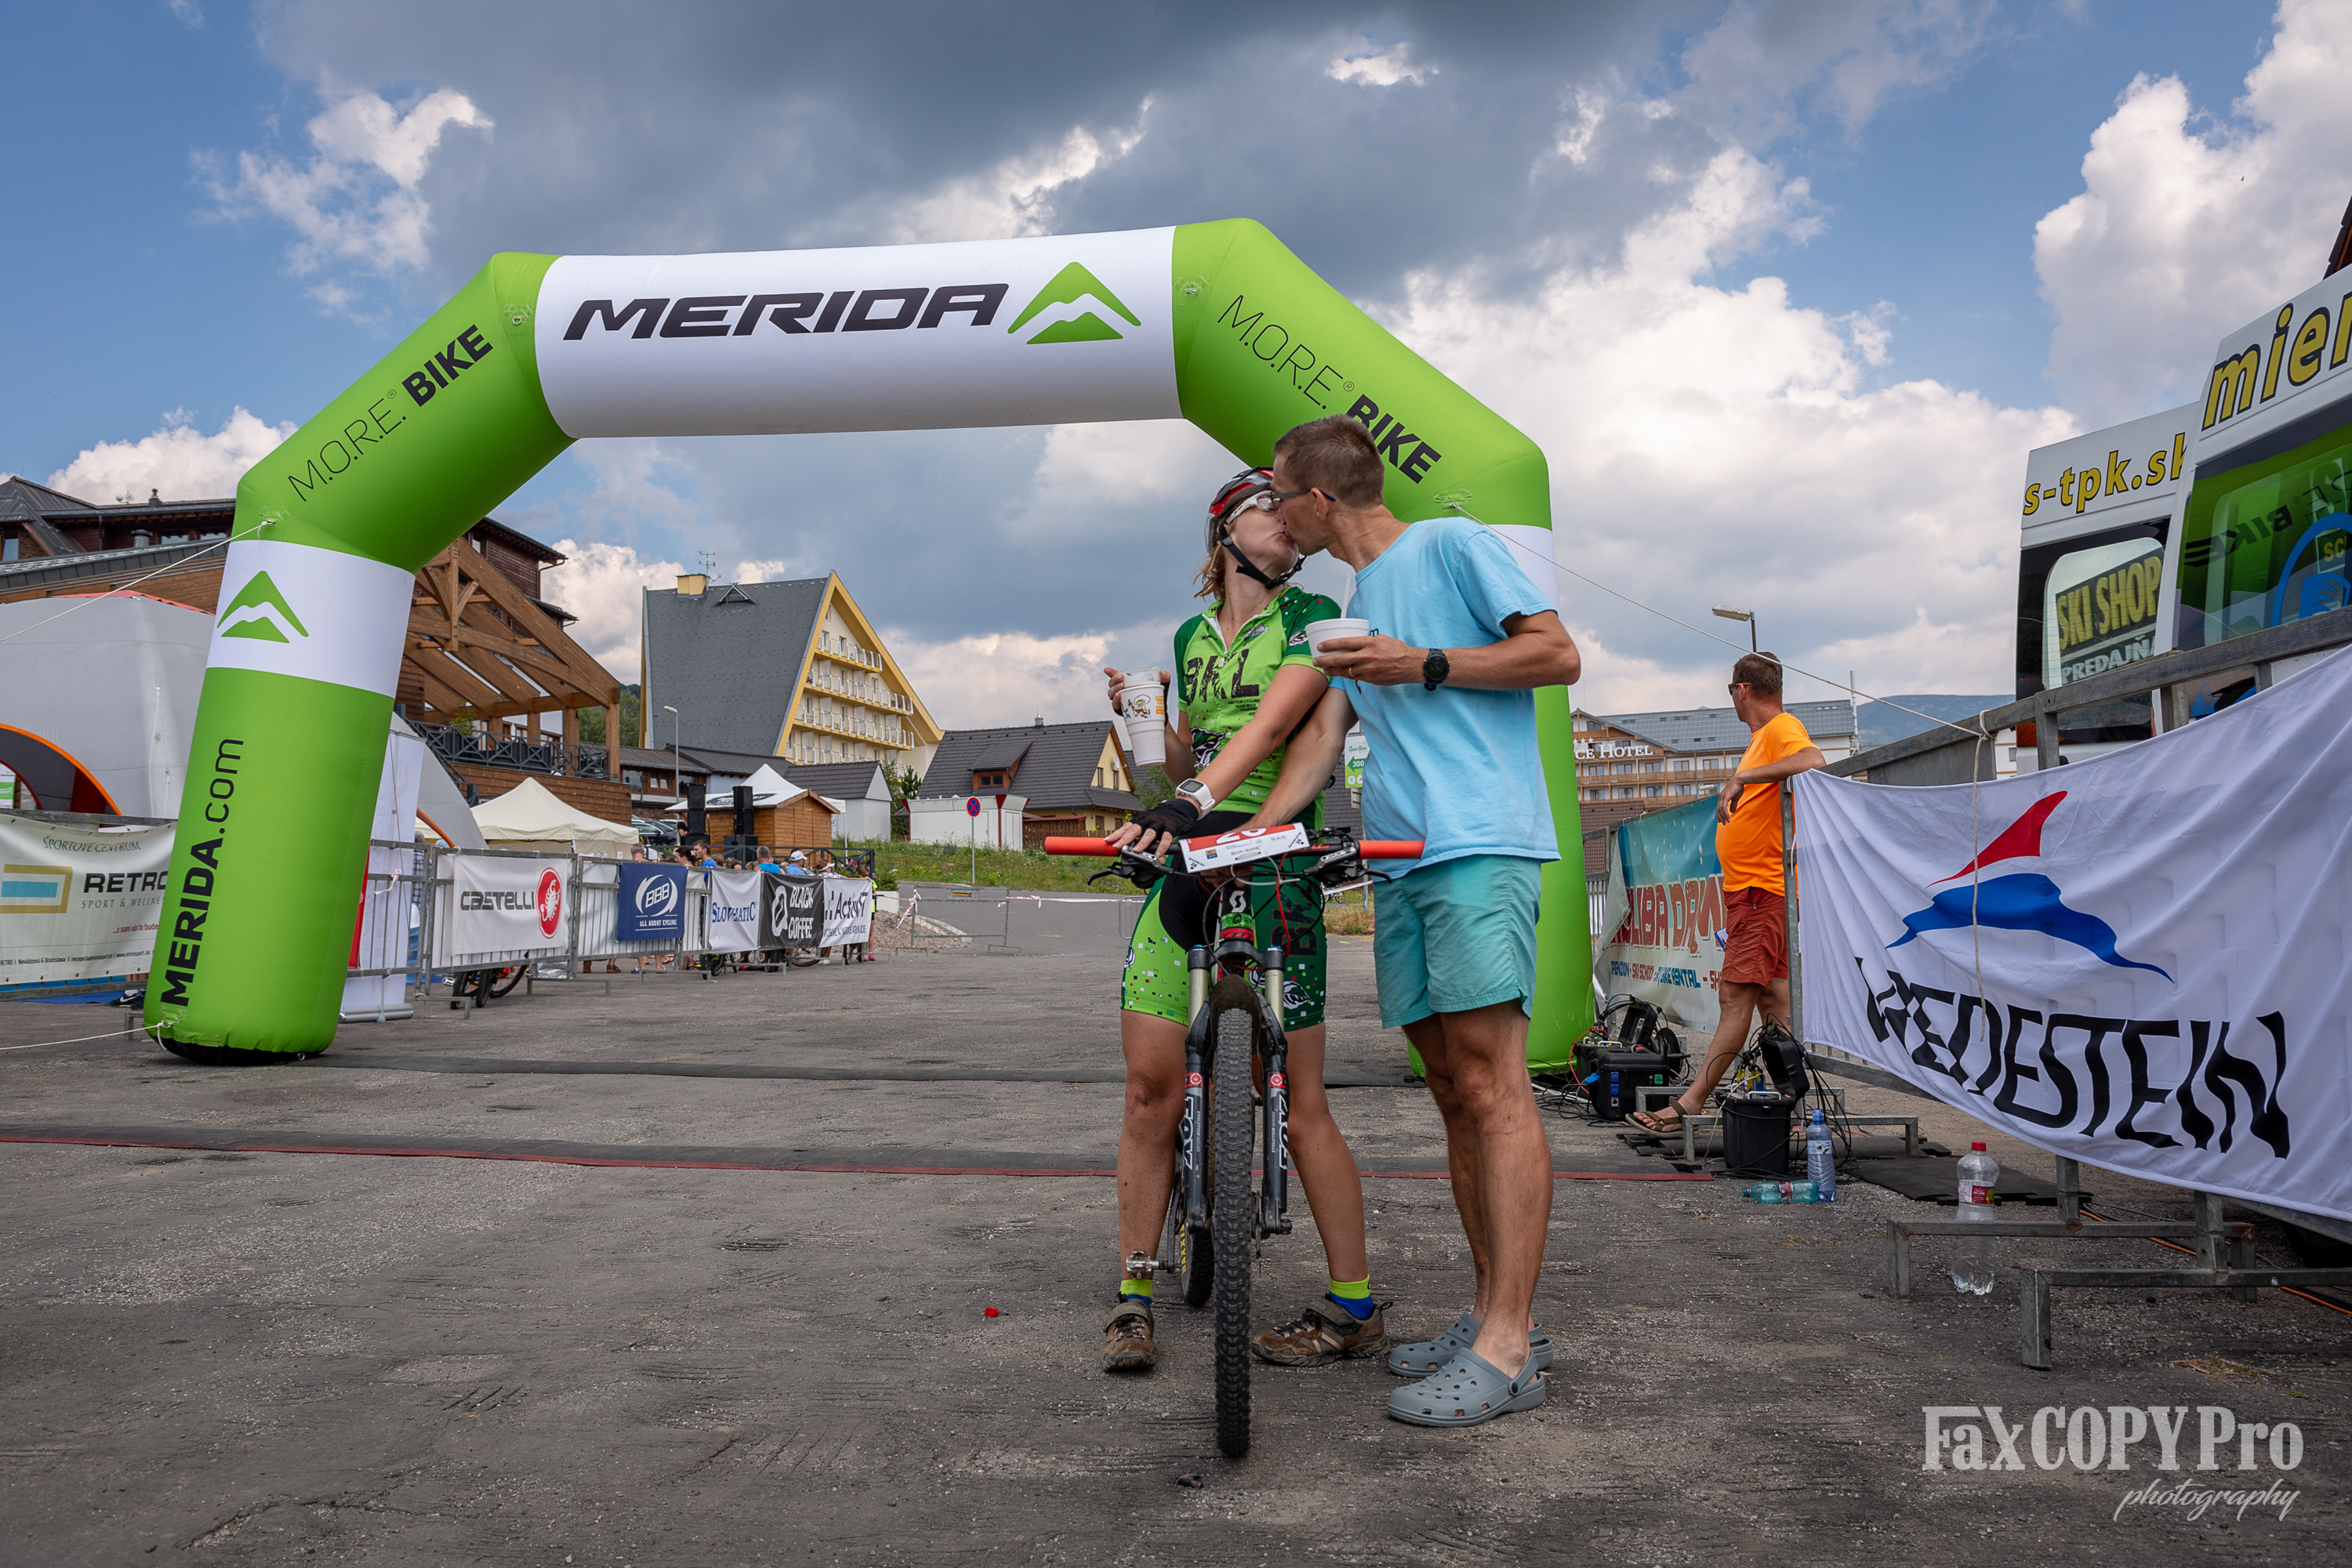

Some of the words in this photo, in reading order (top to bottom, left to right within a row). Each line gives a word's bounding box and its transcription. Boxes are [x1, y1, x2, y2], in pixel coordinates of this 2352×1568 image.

[562, 283, 1009, 340] MERIDA
[401, 323, 494, 408] BIKE
[1346, 393, 1442, 485] BIKE
[2056, 585, 2093, 650] SKI
[2096, 556, 2162, 635] SHOP
[1185, 648, 1259, 706] BKL
[160, 739, 244, 1007] MERIDA.com
[645, 883, 670, 909] BBB
[789, 885, 815, 908] BLACK
[82, 900, 114, 909] SPORT
[119, 898, 125, 907] &
[131, 896, 164, 906] WELLNE
[788, 916, 815, 939] COFFEE
